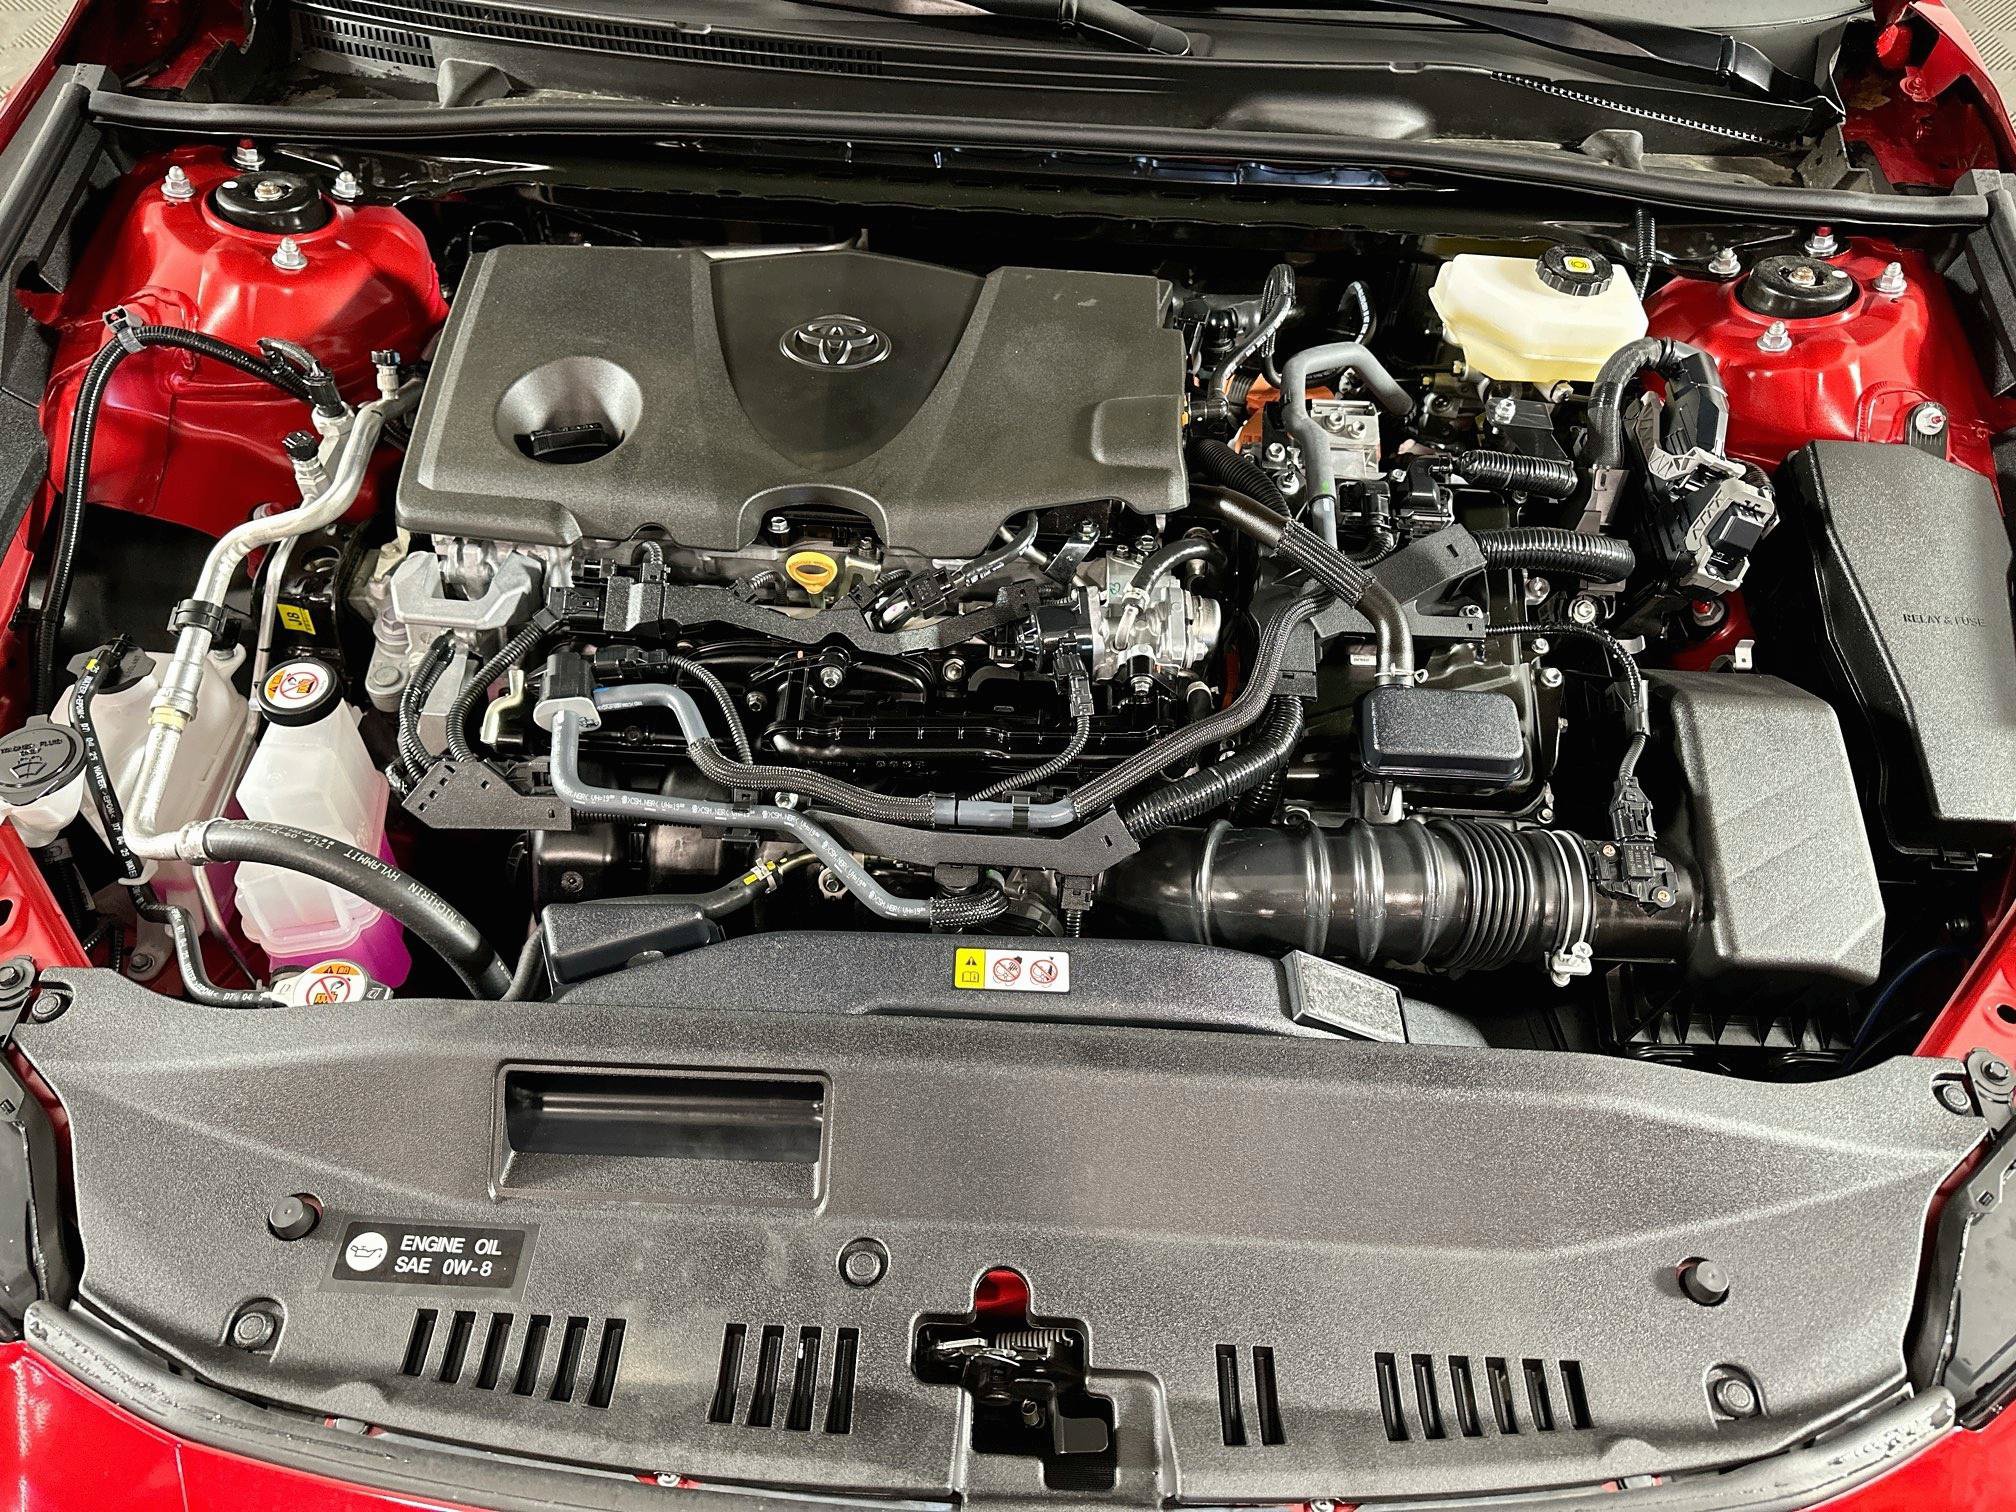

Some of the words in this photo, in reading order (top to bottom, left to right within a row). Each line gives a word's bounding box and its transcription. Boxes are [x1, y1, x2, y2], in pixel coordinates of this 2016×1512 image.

[1903, 613, 1941, 624] RELAY
[94, 765, 107, 790] WATER
[400, 1235, 466, 1253] ENGINE
[474, 1238, 502, 1255] OIL
[394, 1256, 432, 1274] SAE
[442, 1258, 493, 1277] 0W-8
